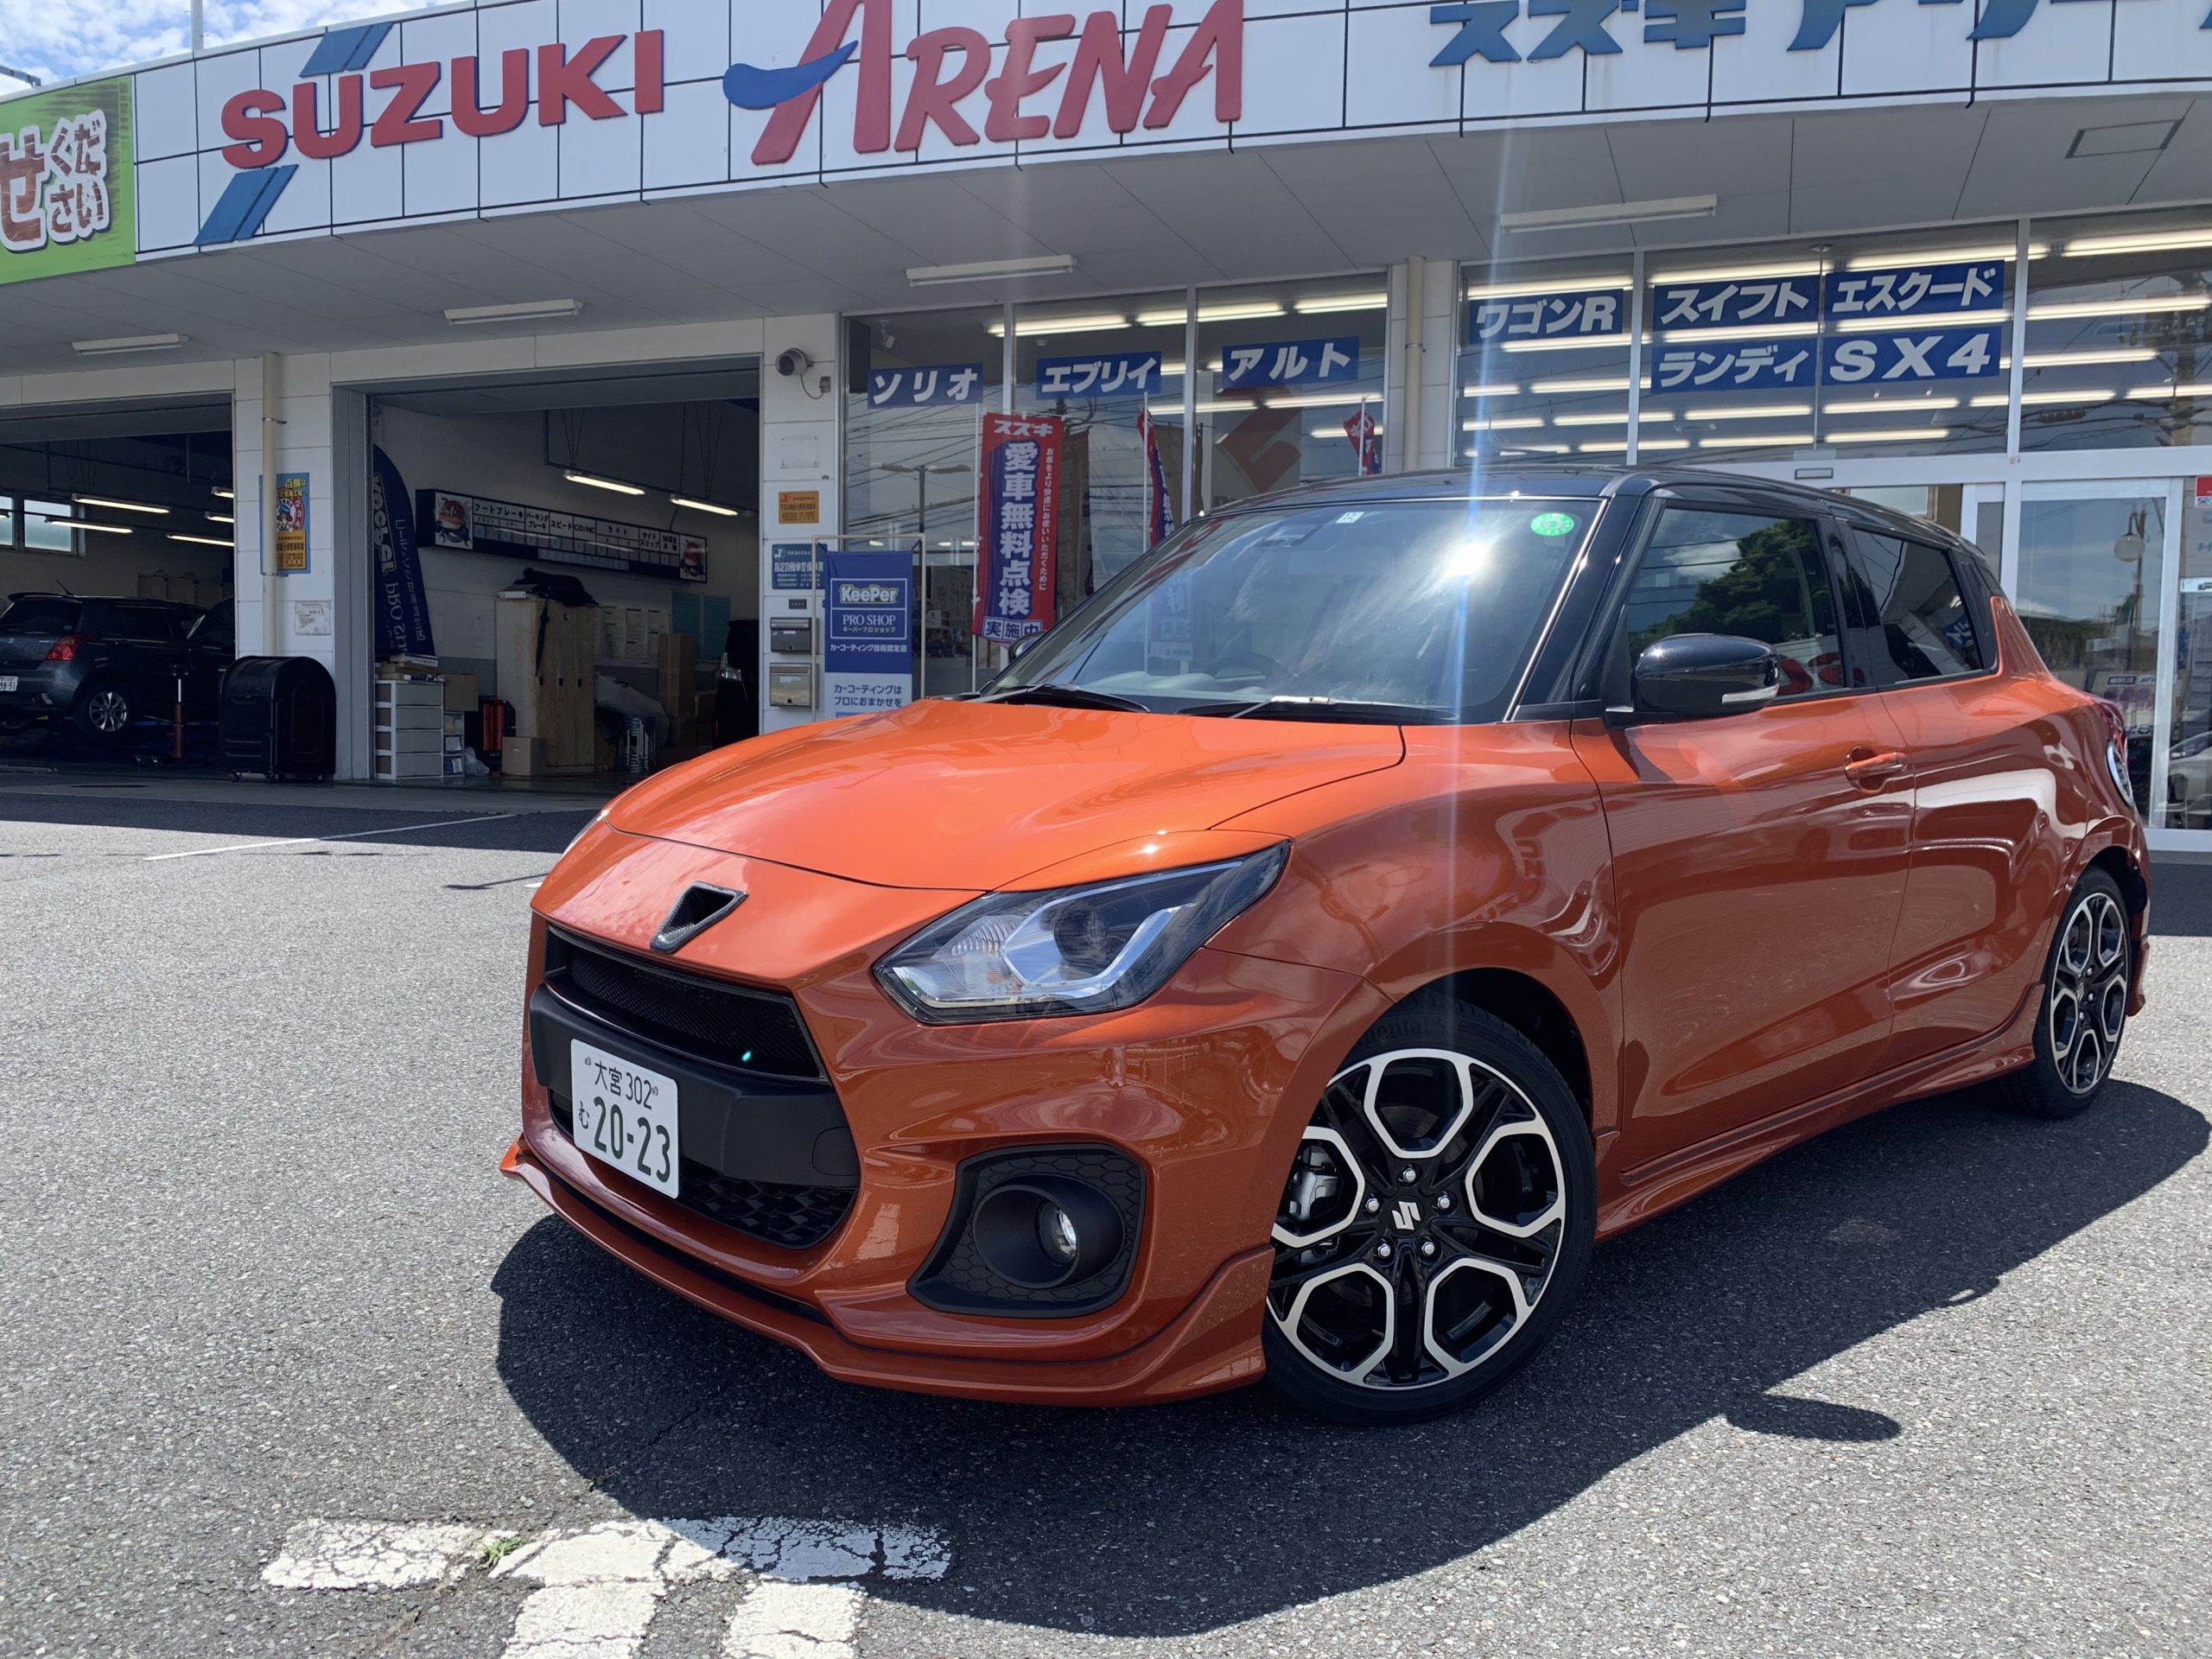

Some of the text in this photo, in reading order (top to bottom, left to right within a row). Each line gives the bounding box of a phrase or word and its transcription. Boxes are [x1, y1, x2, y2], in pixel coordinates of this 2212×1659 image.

[221, 0, 1244, 169] SUZUKI ARENA
[1660, 282, 1809, 325] スイフト
[1832, 266, 1997, 313] エスクード
[1476, 296, 1618, 340] ワゴンR
[1041, 357, 1157, 394] エブリイ
[1229, 342, 1351, 381] アルト
[1658, 345, 1809, 388] ランディ
[1829, 333, 1992, 382] SX4
[873, 369, 978, 404] ソリオ
[994, 419, 1053, 437] スズキ
[550, 520, 573, 531] スピード
[999, 442, 1039, 615] 愛車無料点検
[840, 584, 899, 604] KeePer
[842, 614, 896, 626] PRO SHOP
[985, 620, 1039, 638] 実施中
[833, 683, 902, 695] カーコーティングは
[834, 696, 902, 708] プロにおまかせを
[578, 1100, 590, 1130] む
[593, 1096, 671, 1184] 20-23
